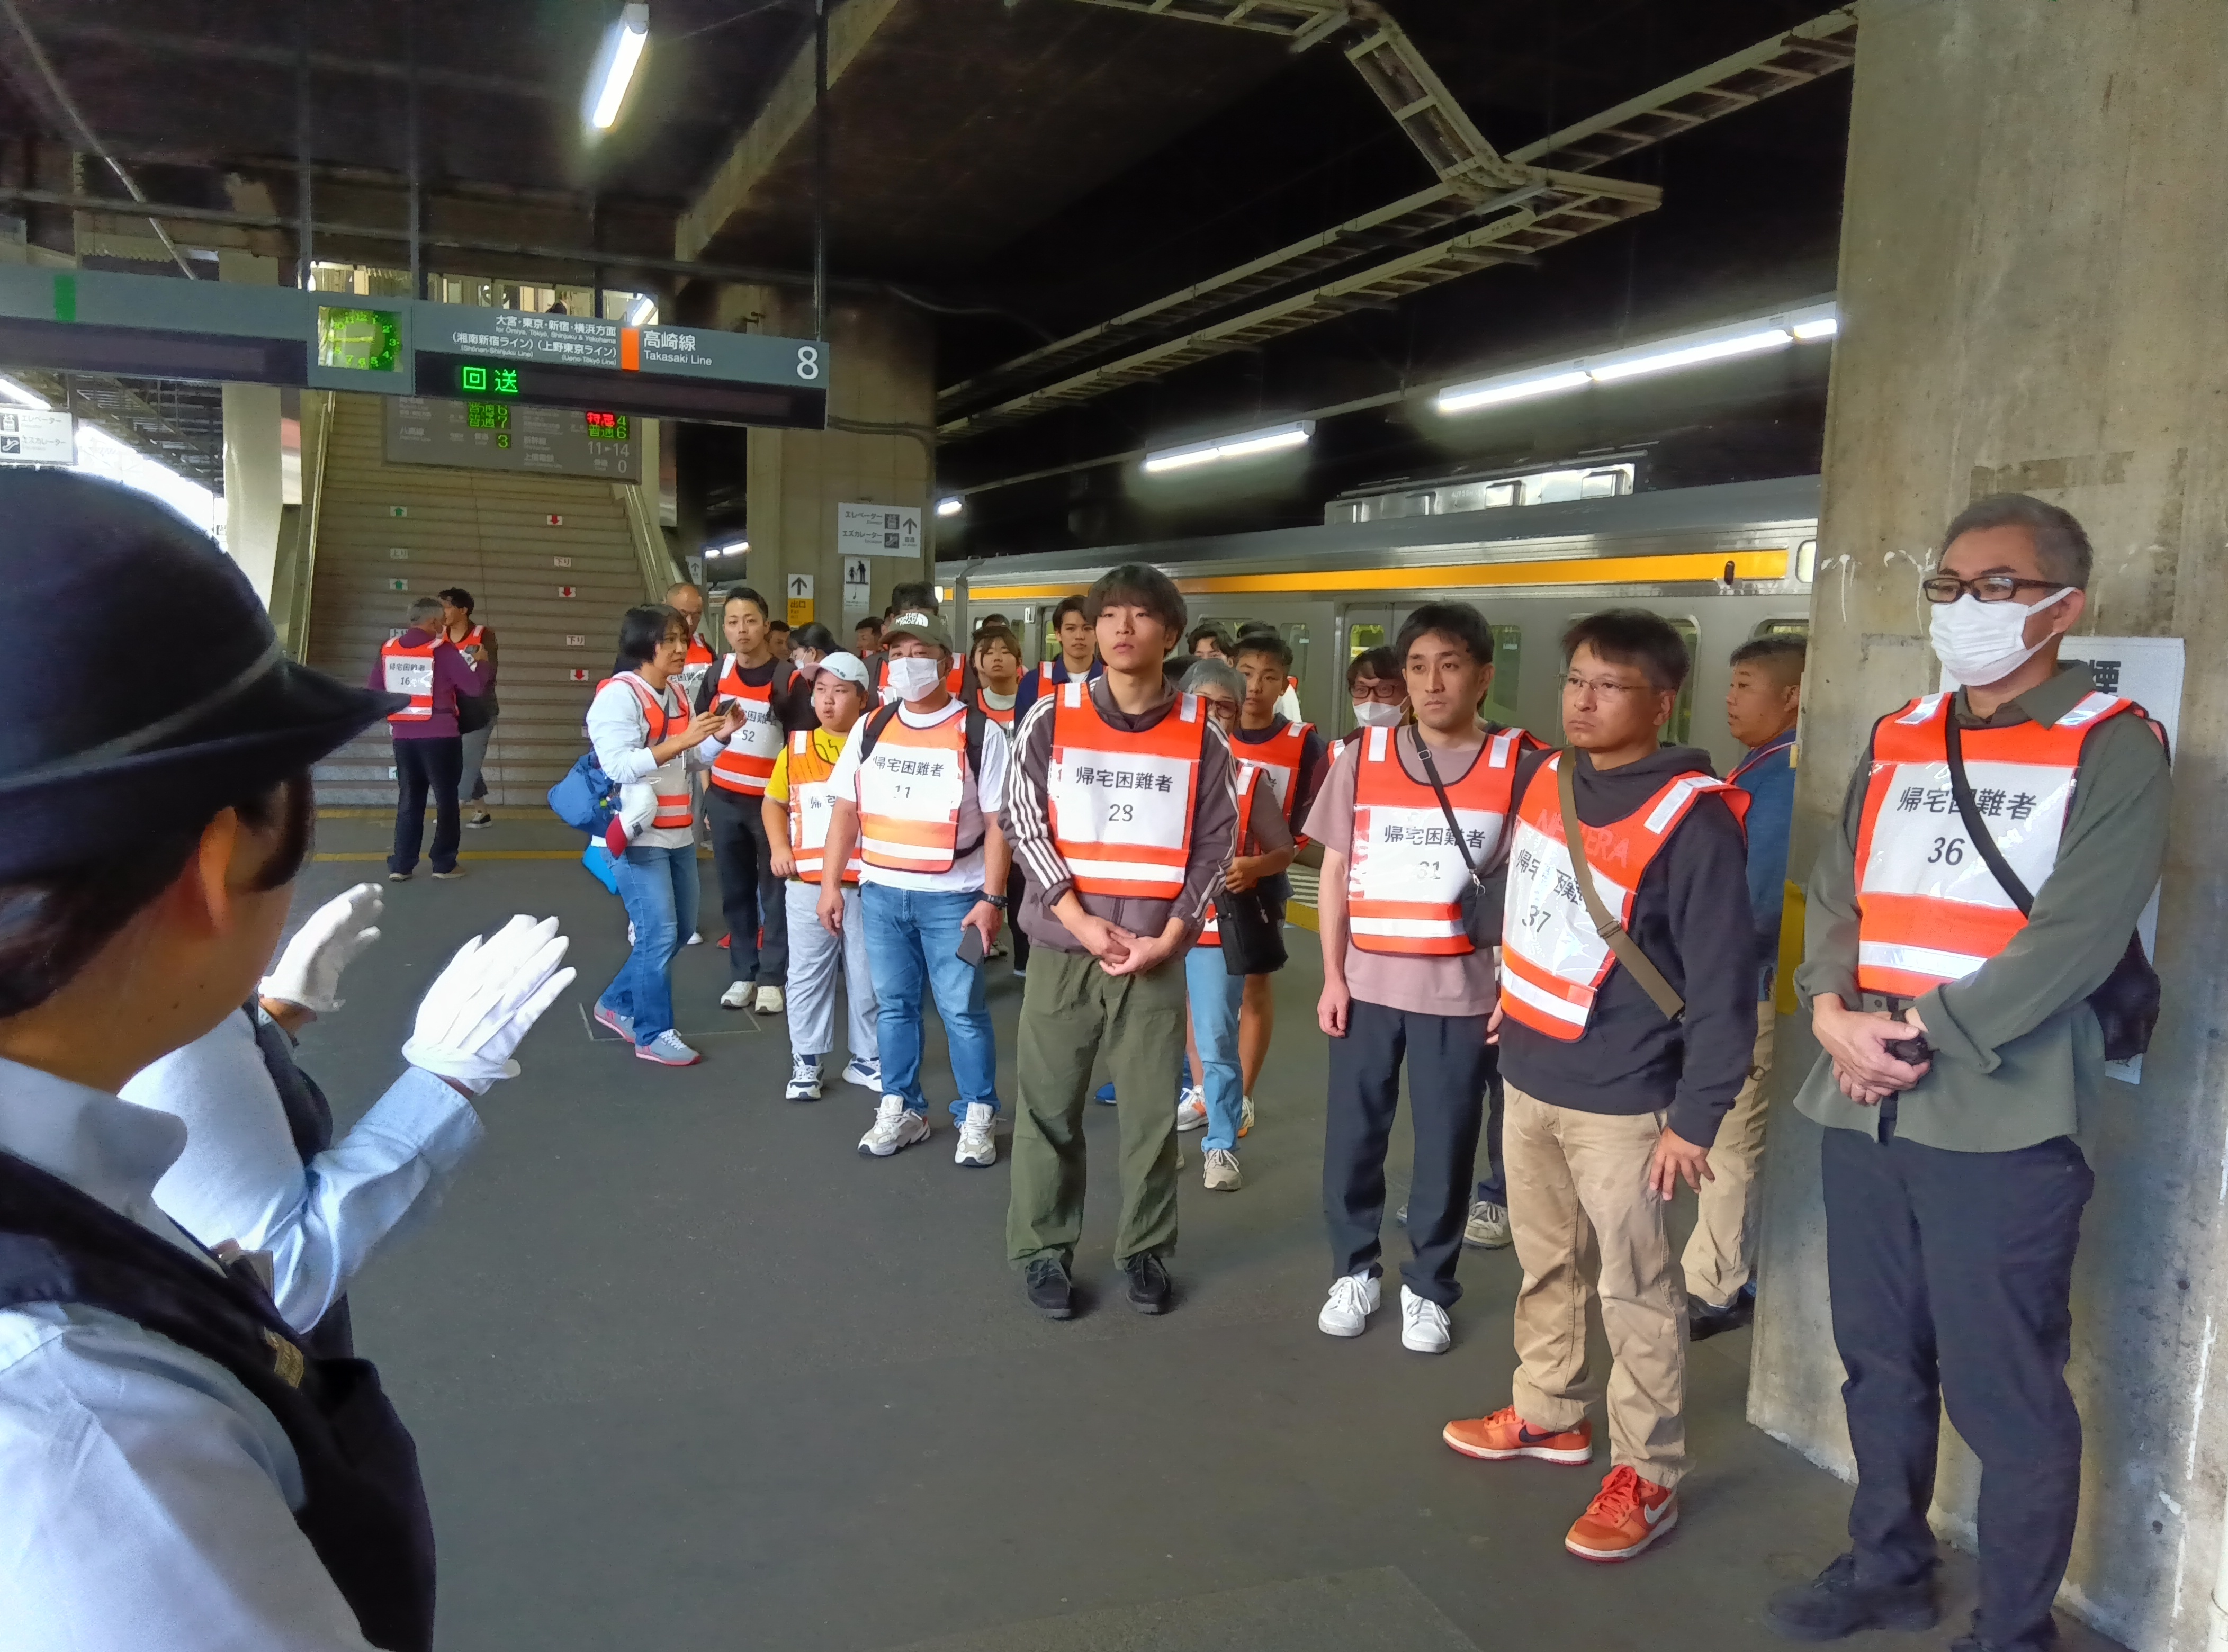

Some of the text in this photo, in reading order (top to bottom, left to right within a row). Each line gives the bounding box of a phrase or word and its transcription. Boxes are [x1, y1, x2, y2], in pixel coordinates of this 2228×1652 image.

[495, 315, 616, 337] 大宮・東京・新宿・横浜方面
[389, 338, 396, 347] 3
[643, 330, 696, 352] 高崎線
[643, 349, 712, 366] Takasaki Line
[796, 346, 819, 380] 8
[617, 415, 627, 426] 4
[588, 425, 627, 439] 普通 6
[498, 434, 508, 448] 3
[617, 459, 627, 474] 0
[400, 677, 410, 686] 16
[742, 729, 755, 742] 52
[873, 755, 945, 777] 帰宅困難者
[1076, 766, 1173, 793] 帰宅困難者
[1927, 837, 1966, 866] 36
[1521, 904, 1552, 933] 37
